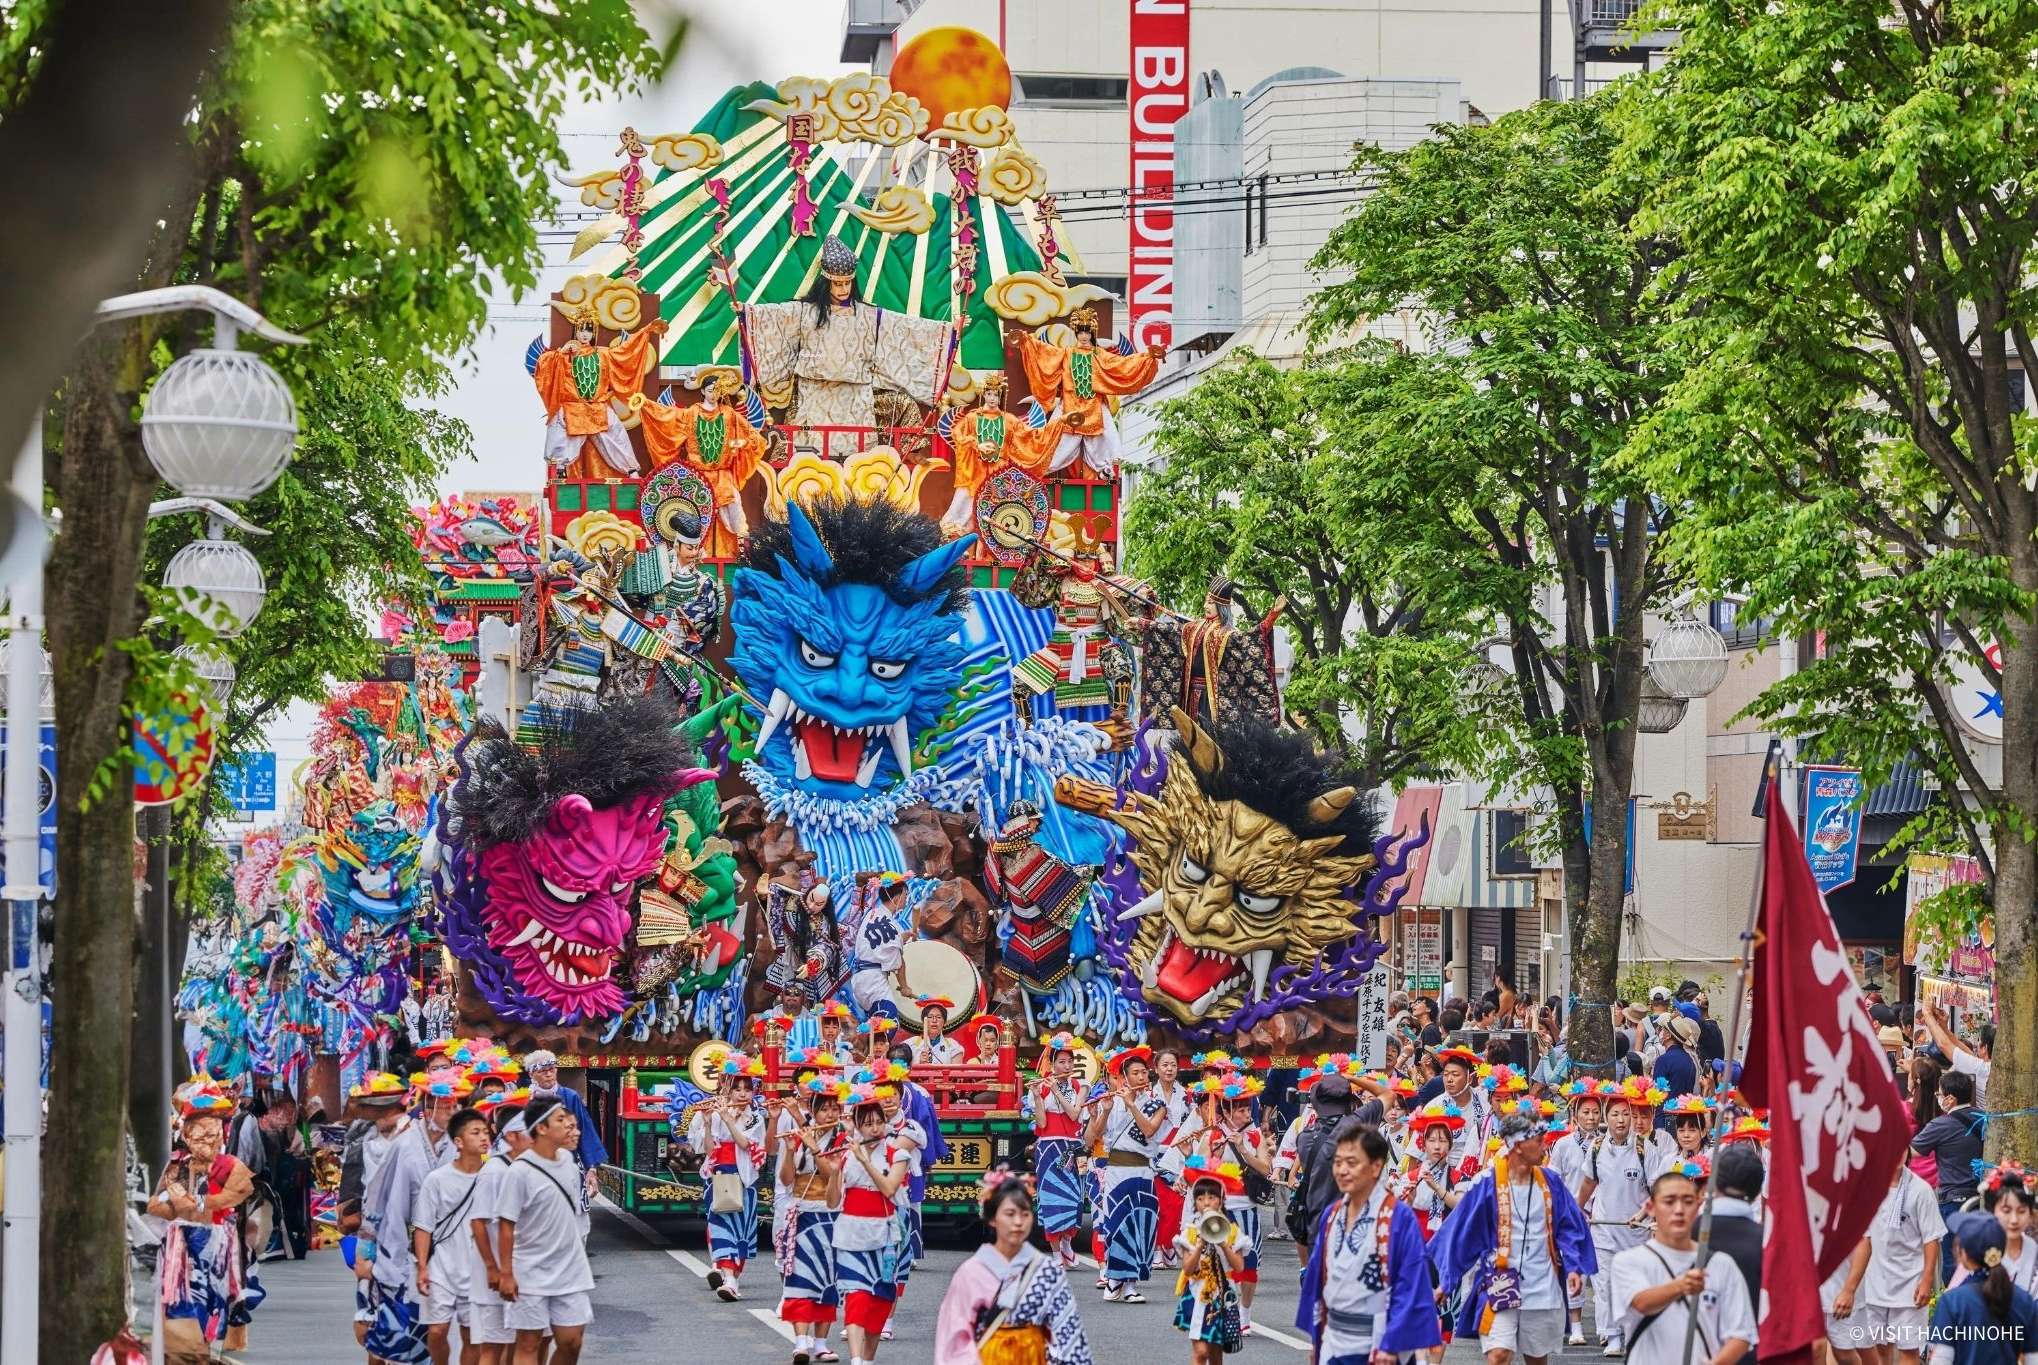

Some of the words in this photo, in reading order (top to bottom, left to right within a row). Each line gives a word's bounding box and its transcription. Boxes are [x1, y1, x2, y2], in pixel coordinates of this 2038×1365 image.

[786, 113, 818, 237] 国なれば
[1134, 46, 1185, 353] BUILDING
